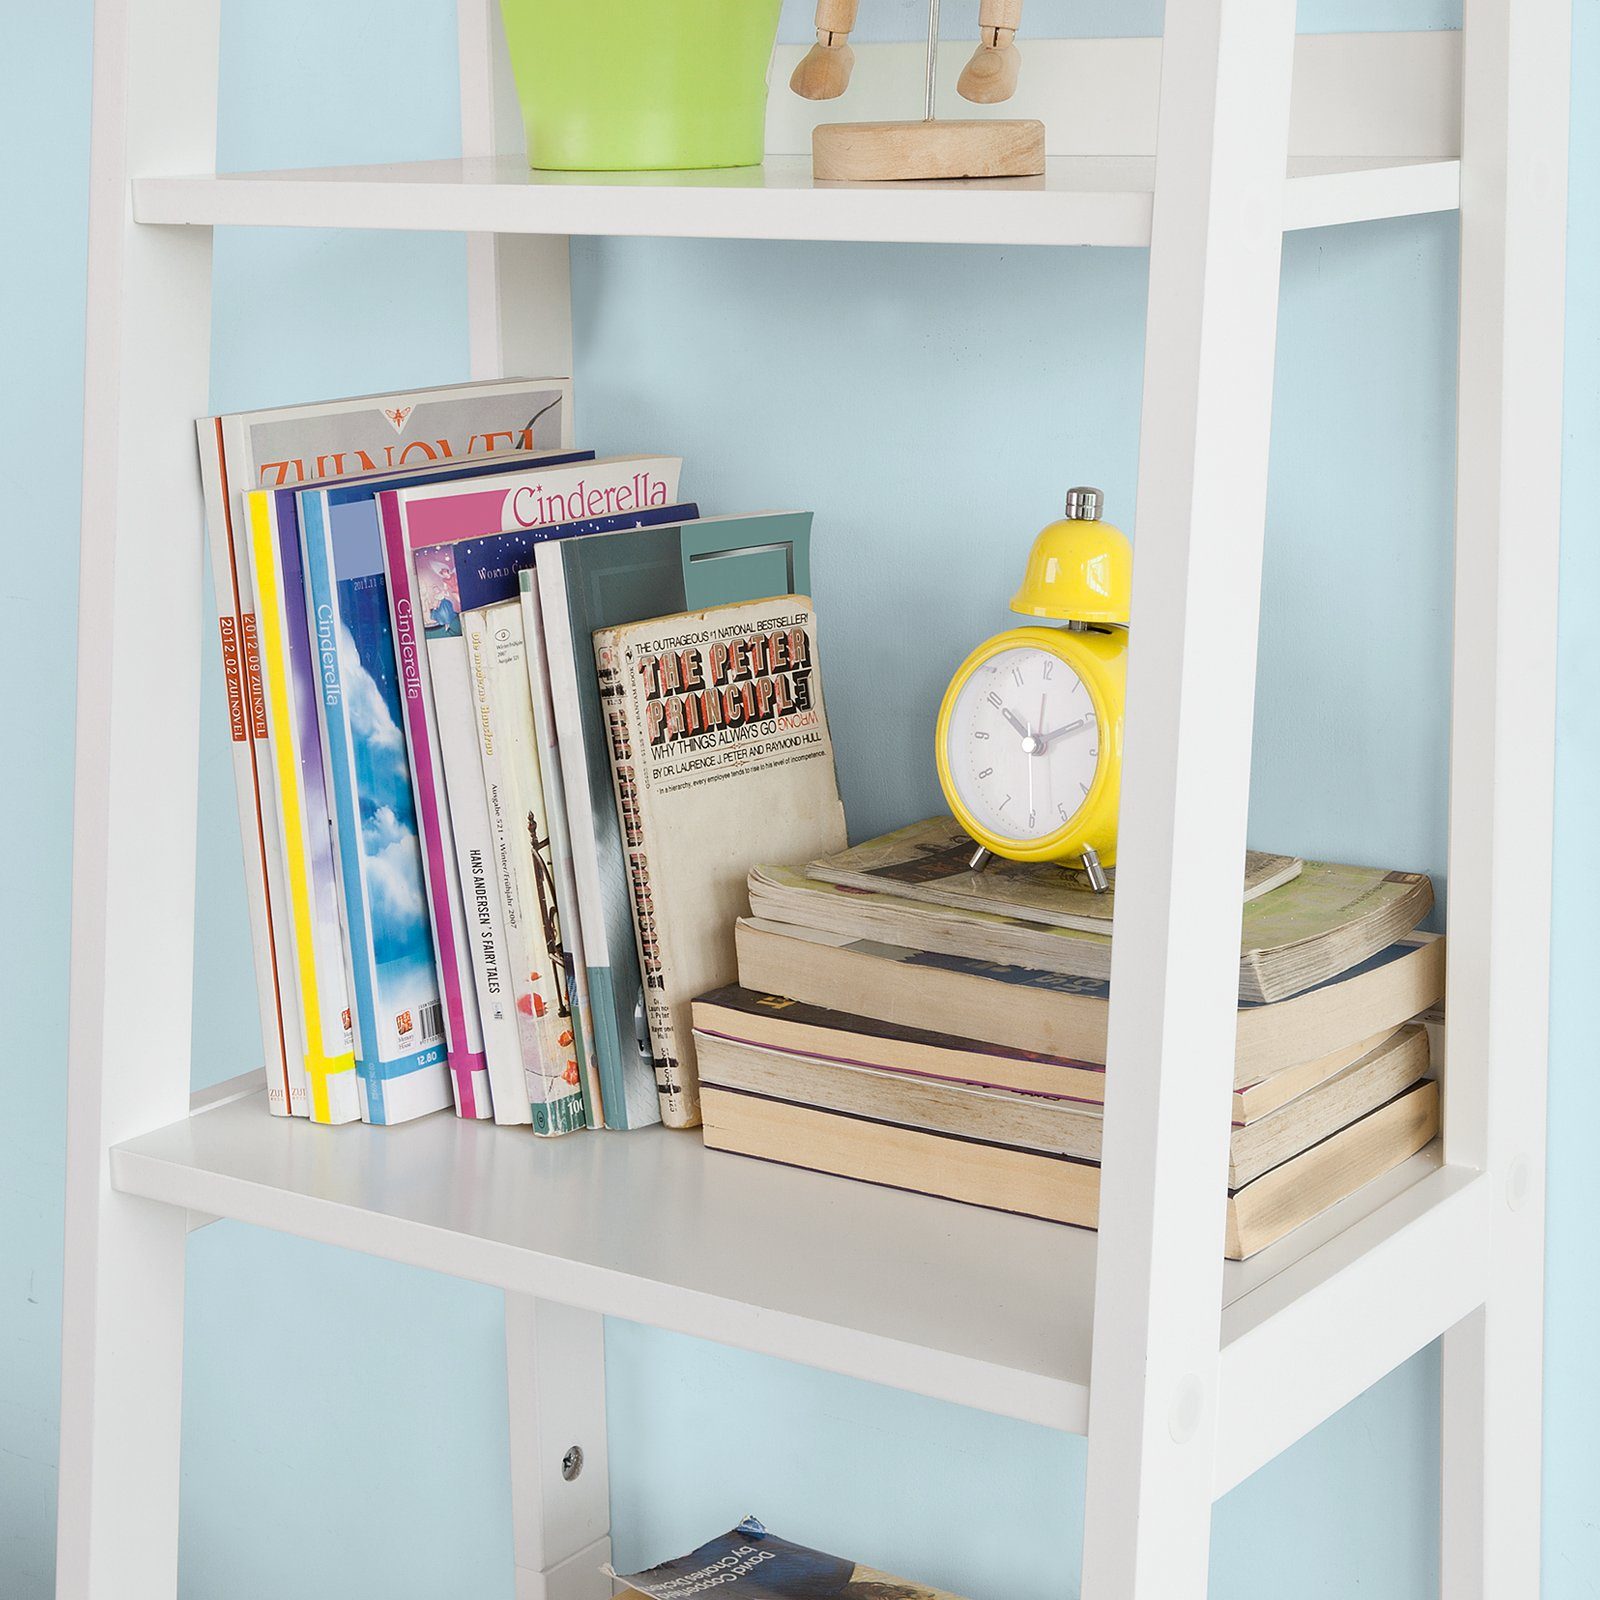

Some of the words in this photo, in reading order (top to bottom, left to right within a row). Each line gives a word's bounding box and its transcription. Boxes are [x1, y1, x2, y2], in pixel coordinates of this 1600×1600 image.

[512, 472, 667, 527] Cinderella
[221, 618, 238, 675] 2012.02
[244, 616, 261, 672] 2012.09
[397, 598, 420, 700] Cinderella
[635, 642, 652, 654] THE
[653, 631, 710, 652] OUTRAGEOUS
[718, 623, 756, 639] NATIONAL
[316, 604, 341, 706] Cinderella
[638, 648, 705, 701] THE
[709, 624, 812, 685] PETER
[1011, 667, 1024, 688] 11
[1043, 660, 1054, 681] 12
[228, 678, 240, 698] ZUI
[251, 675, 262, 695] ZUI
[646, 668, 815, 746] PRINCIPLE
[987, 691, 1003, 710] 10
[231, 700, 243, 740] NOVEL
[254, 697, 266, 737] NOVEL
[608, 709, 632, 761] THE
[651, 742, 676, 760] WHY
[718, 724, 758, 746] ALWAYS
[760, 720, 777, 736] GO
[653, 769, 662, 780] BY
[676, 756, 716, 774] LAURENCE
[724, 749, 748, 764] PETER
[750, 745, 764, 756] AND
[766, 736, 802, 752] RAYMOND
[802, 732, 822, 744] HULL
[693, 779, 707, 787] every
[708, 772, 730, 783] employee
[731, 769, 745, 778] tends
[774, 759, 784, 768] level
[979, 767, 994, 780] 8
[617, 765, 644, 848] PETER
[999, 794, 1012, 810] 7
[1057, 803, 1068, 822] 5
[470, 849, 483, 875] HANS
[491, 783, 501, 817] Ausgabe
[496, 818, 504, 834] 521
[508, 910, 517, 930] 2007
[482, 940, 498, 966] FAIRY
[487, 967, 500, 994] TALES
[417, 1051, 438, 1066] 12.80
[731, 1550, 776, 1576] David
[732, 1545, 757, 1559] by
[684, 1556, 739, 1581] Charles
